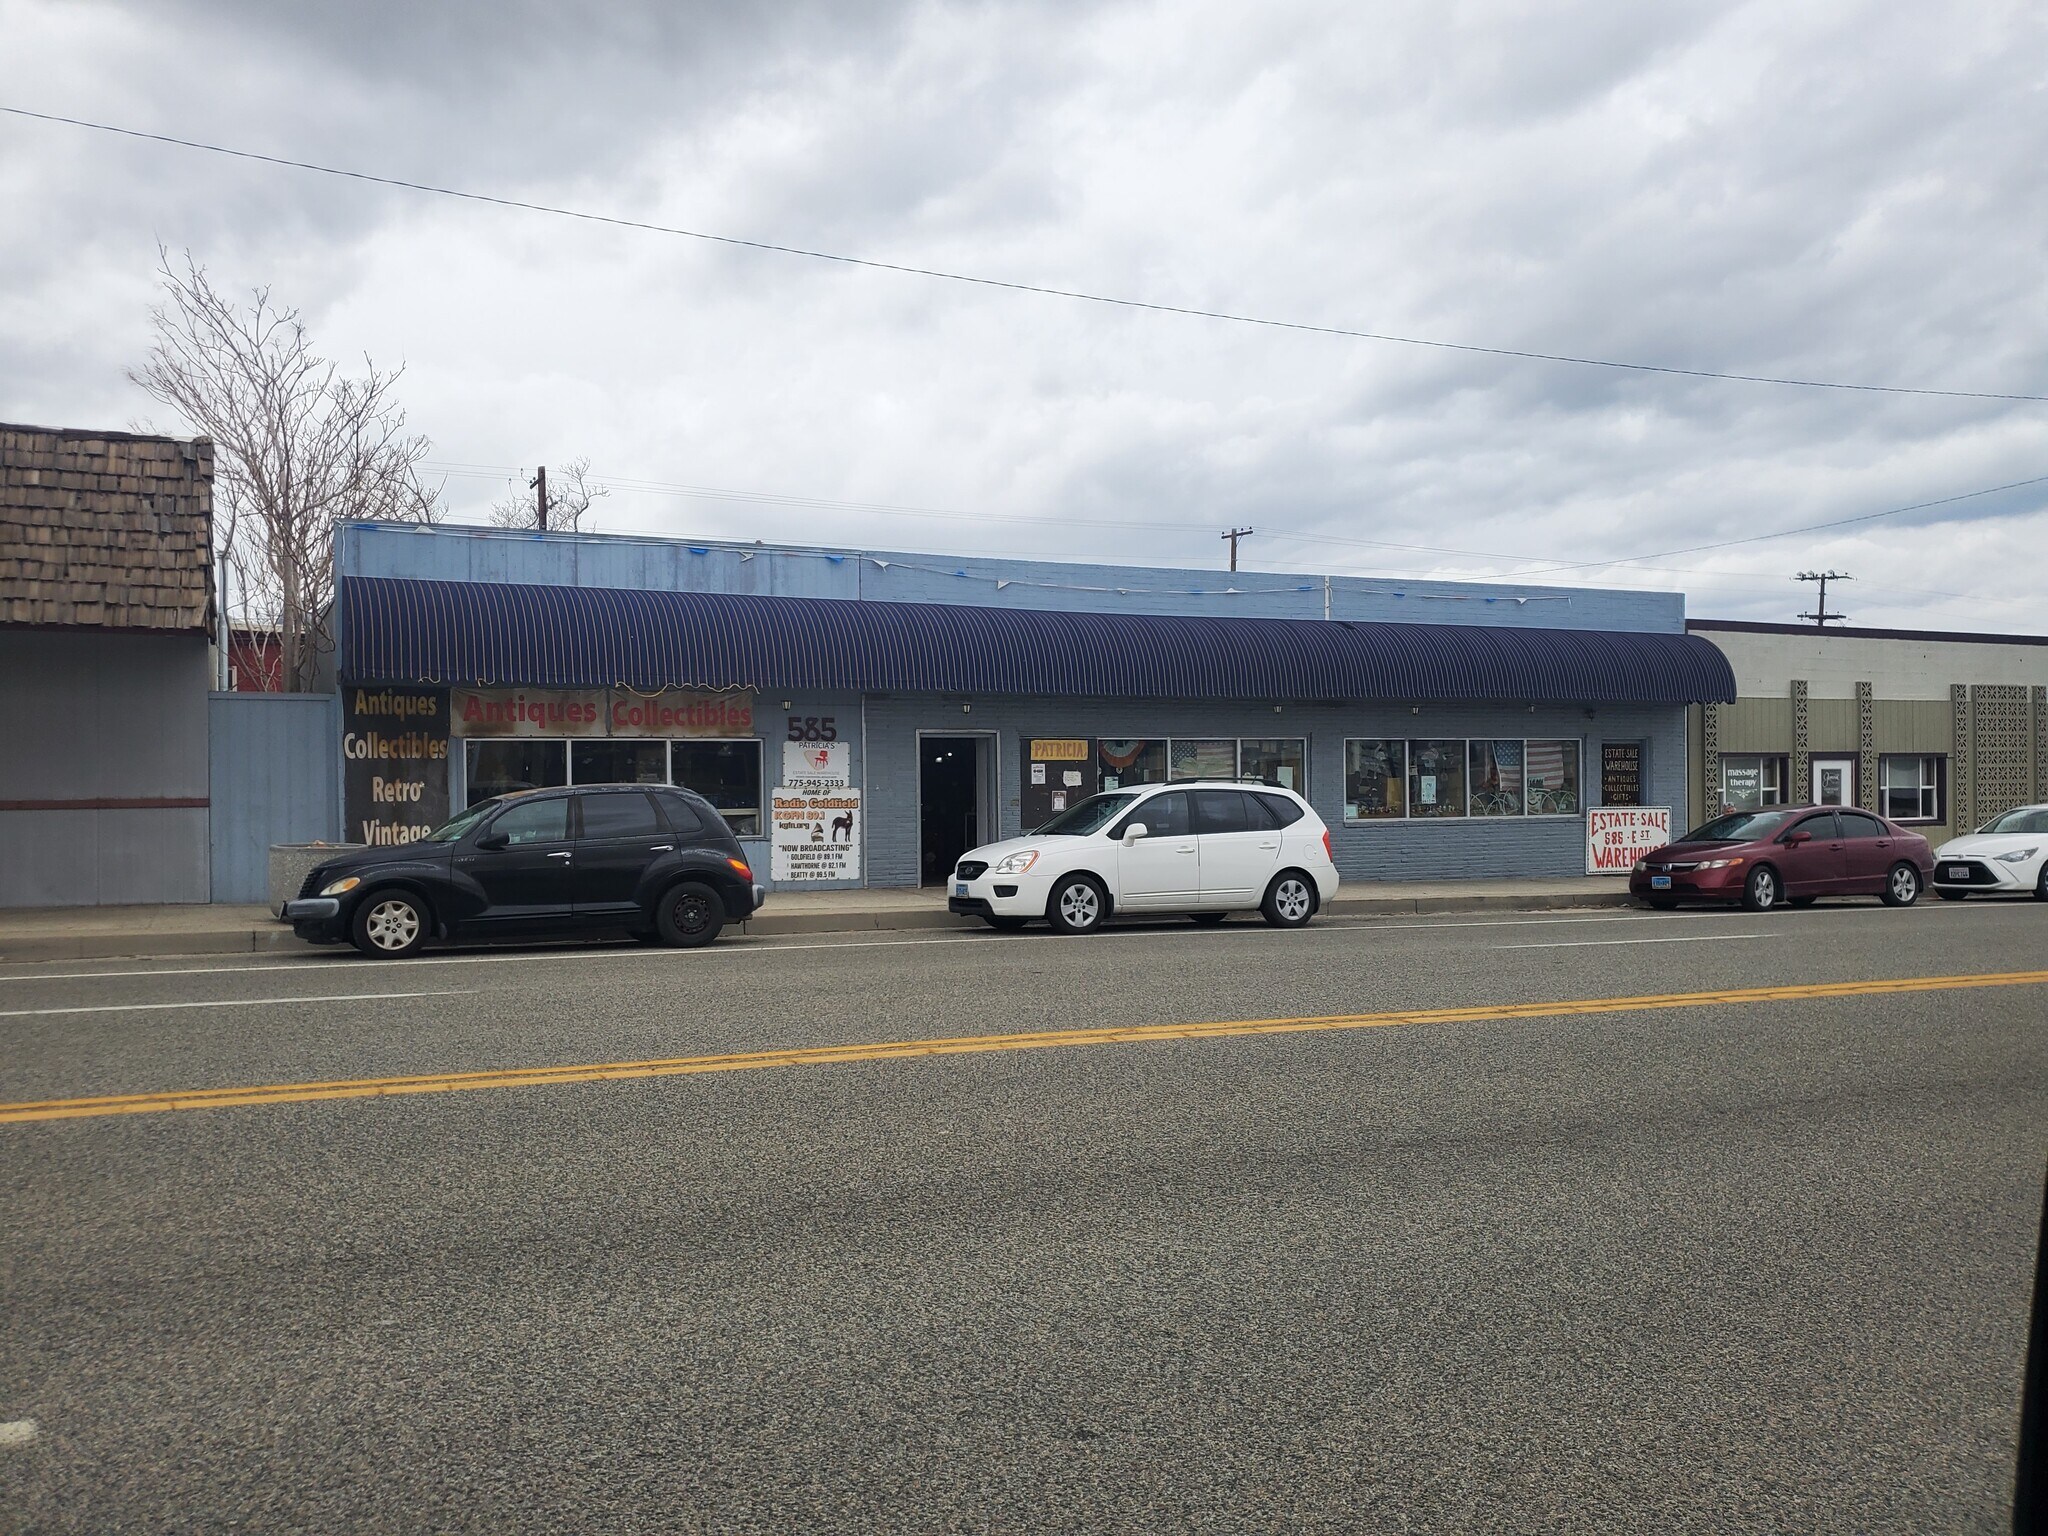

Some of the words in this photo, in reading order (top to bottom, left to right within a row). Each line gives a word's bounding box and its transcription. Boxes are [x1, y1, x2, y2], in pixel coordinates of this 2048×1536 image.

[354, 688, 437, 722] Antiques
[463, 695, 597, 728] Antiques
[612, 700, 751, 727] Collectibles
[788, 716, 837, 741] 585
[344, 731, 449, 760] Collectibles
[798, 741, 836, 749] PATRICIA'S
[1604, 748, 1625, 759] ESTATE
[1625, 748, 1639, 759] SALE
[1604, 760, 1639, 771] WAREHOUSE
[1727, 768, 1759, 777] massage
[788, 779, 845, 787] 775-945-2333
[1730, 778, 1757, 787] therapy
[372, 776, 421, 802] Retro
[774, 797, 808, 809] Radio
[808, 797, 859, 810] Goldfield
[774, 811, 805, 821] KGFN
[805, 811, 826, 821] 89.1
[1591, 812, 1637, 838] ESTATE
[1641, 812, 1668, 834] SALE
[1604, 831, 1624, 846] 585
[790, 853, 815, 861] GOLDFIELD
[790, 862, 820, 870] HAWTHORNE
[790, 871, 808, 879] BEATTY
